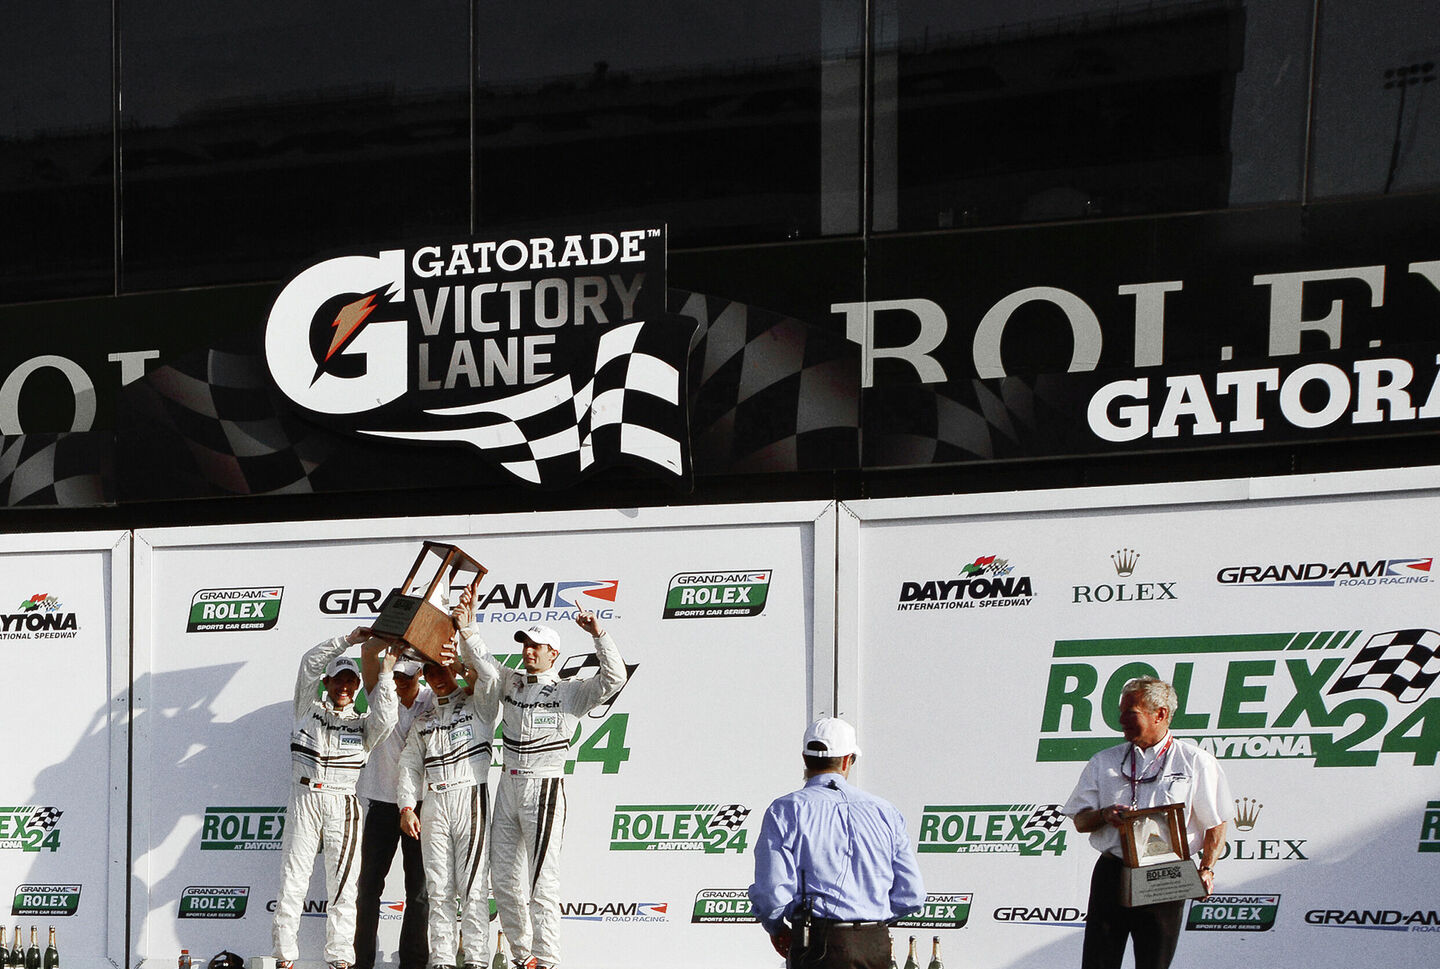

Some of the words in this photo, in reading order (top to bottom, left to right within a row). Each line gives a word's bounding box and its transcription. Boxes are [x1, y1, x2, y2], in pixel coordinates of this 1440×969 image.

[413, 273, 646, 336] VICTORY
[418, 334, 556, 391] LANE
[899, 577, 1032, 602] DAYTONA
[1339, 579, 1377, 587] ROAD
[1379, 576, 1428, 585] RACING
[681, 587, 752, 605] ROLEX
[1072, 582, 1178, 603] ROLEX
[203, 602, 265, 620] ROLEX
[898, 601, 975, 611] INTERNATIONAL
[979, 599, 1032, 608] SPEEDWAY
[490, 611, 542, 622] ROAD
[1314, 698, 1440, 768] 24
[23, 830, 61, 852] 24
[611, 814, 713, 840] ROLEX
[704, 829, 748, 854] 24
[919, 815, 1030, 842] ROLEX
[1020, 830, 1067, 856] 24
[657, 842, 705, 850] DAYTONA
[969, 844, 1020, 853] DAYTONA
[23, 895, 68, 907] ROLEX
[190, 898, 235, 909] ROLEX
[1202, 907, 1262, 920] ROLEX
